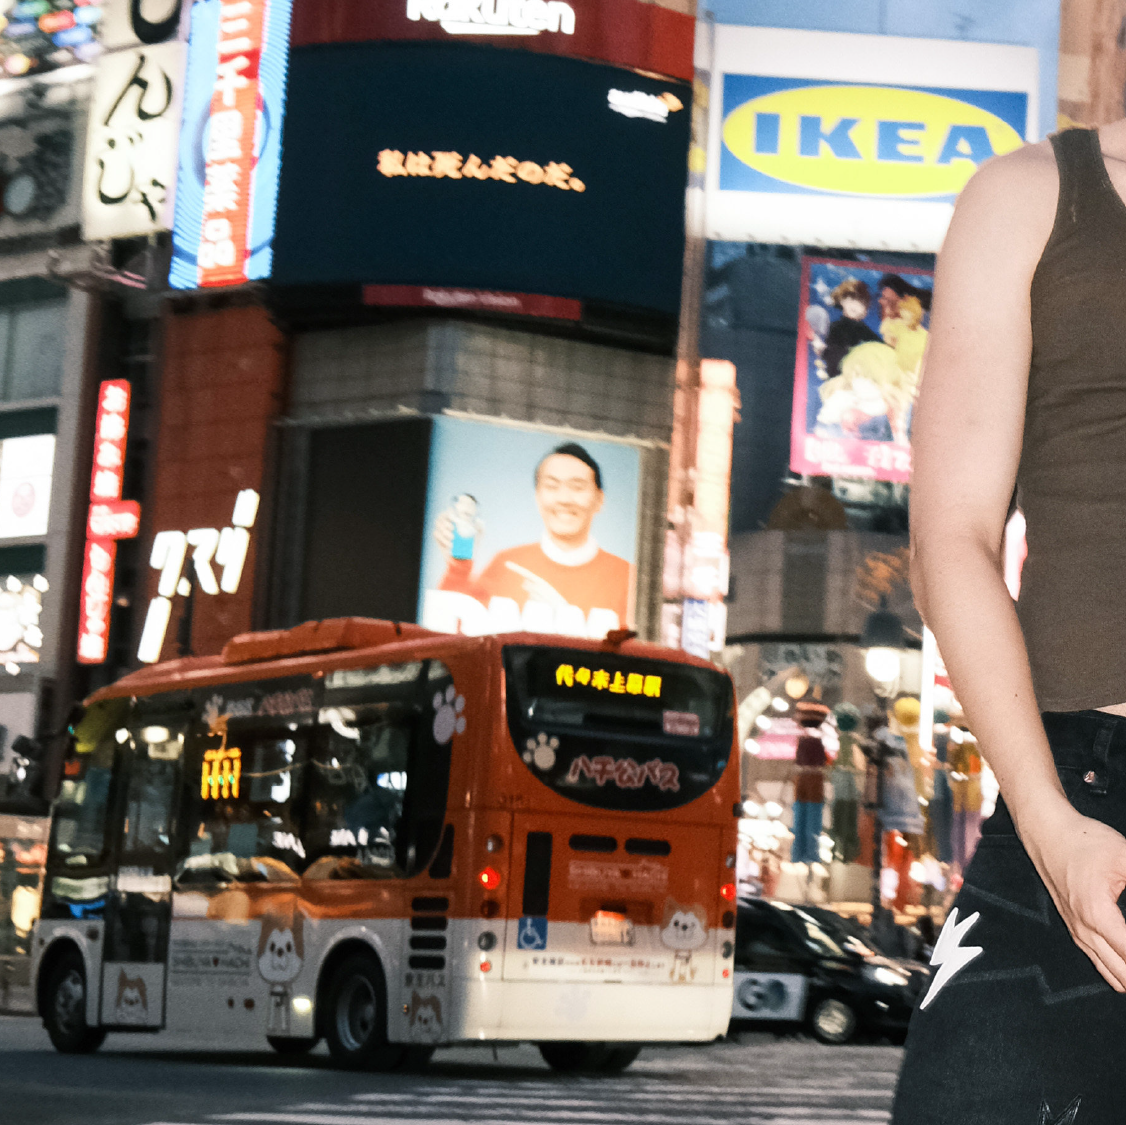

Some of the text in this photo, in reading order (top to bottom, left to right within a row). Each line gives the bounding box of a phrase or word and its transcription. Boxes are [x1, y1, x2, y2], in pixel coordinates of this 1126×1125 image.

[753, 112, 995, 165] IKEA
[566, 754, 681, 793] ハチ公バス
